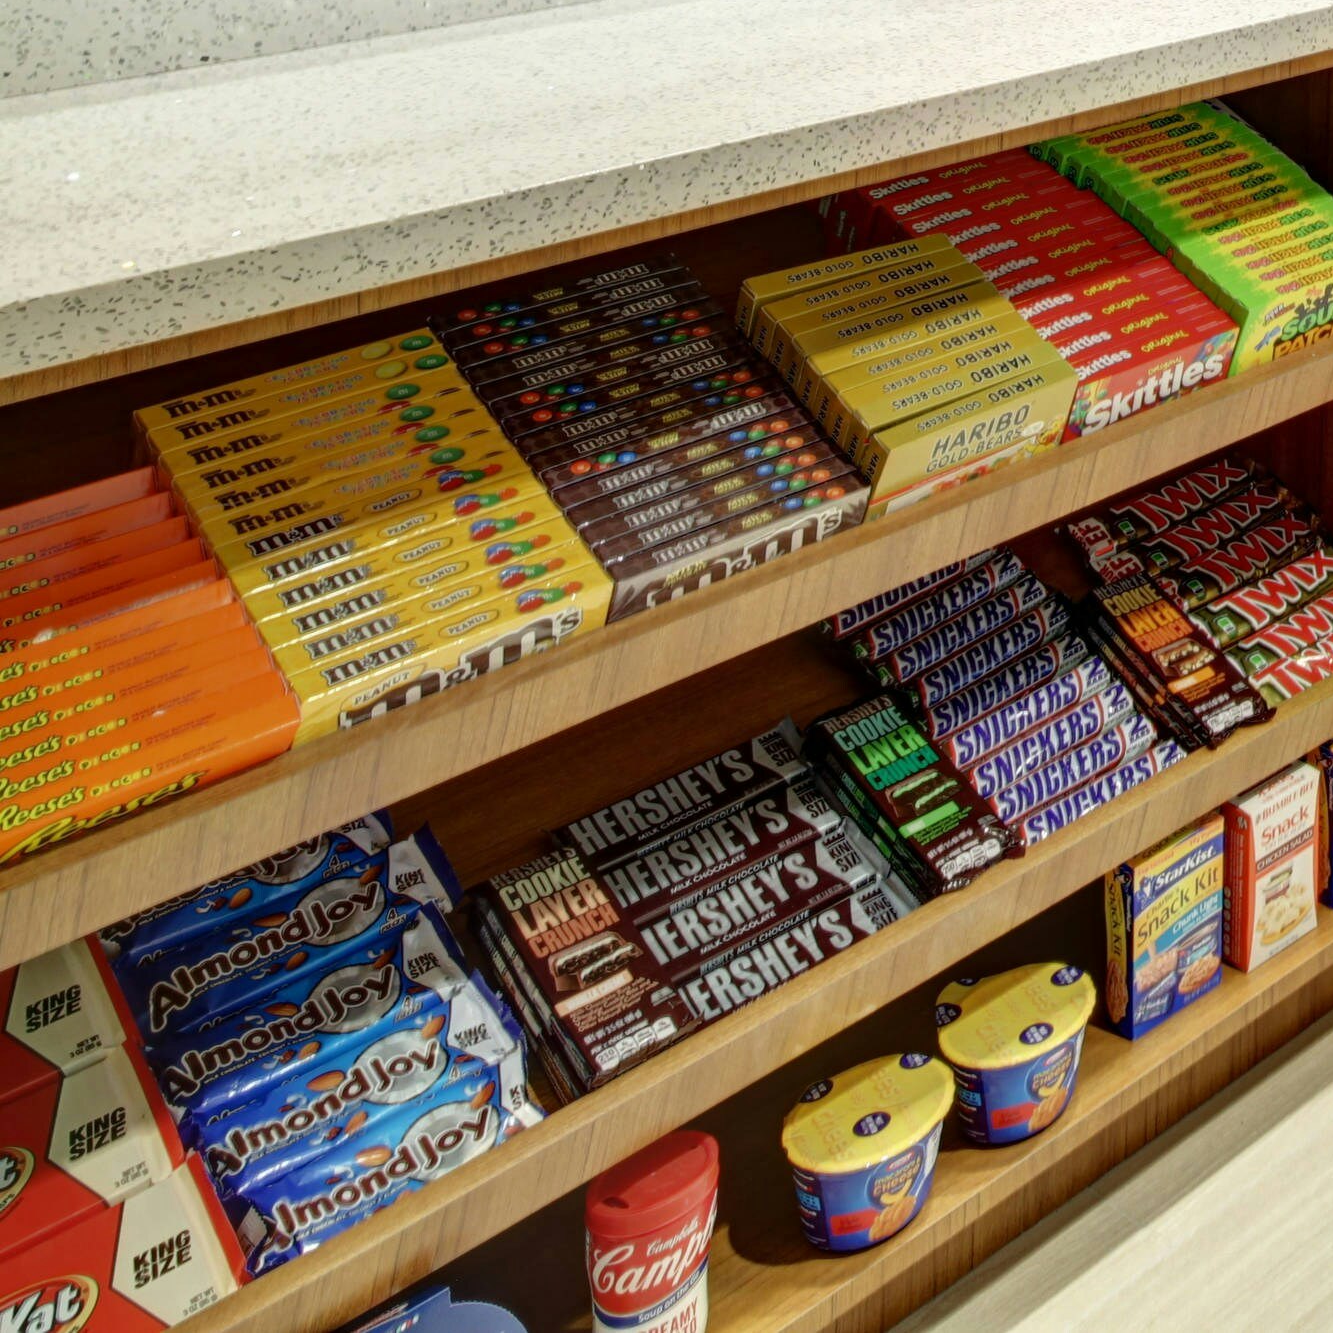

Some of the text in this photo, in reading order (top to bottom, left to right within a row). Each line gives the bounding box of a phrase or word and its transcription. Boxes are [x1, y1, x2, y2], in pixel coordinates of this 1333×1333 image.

[1083, 352, 1224, 437] Skittles
[925, 426, 1025, 476] GOLD-BEARS
[931, 404, 1031, 461] HARIBO
[1116, 459, 1248, 533] TWIX
[386, 514, 431, 536] PEANUT
[402, 540, 446, 561] PEANUT
[416, 564, 461, 585] PEANUT
[430, 587, 475, 609] PEANUT
[868, 568, 997, 659] SNICKERS
[1105, 580, 1163, 619] COOKIE
[1119, 601, 1175, 640] LAYER
[446, 612, 491, 635] PEANUT
[898, 591, 1020, 681] SNICKERS
[1136, 618, 1194, 654] CRUNCH
[918, 611, 1044, 707] SNICKERS
[352, 670, 414, 706] PEANUT
[832, 704, 905, 753] COOKIE
[953, 673, 1079, 769] SNICKERS
[848, 735, 929, 775] LAYER
[971, 698, 1102, 798] SNICKERS
[865, 757, 940, 793] CRUNCH
[994, 725, 1126, 822] SNICKERS
[567, 748, 755, 857] HERSHEY'S
[638, 800, 714, 842] MILK CHOCOLATE
[1261, 805, 1310, 847] Snack
[602, 798, 791, 910] HERSHEY'S
[1154, 845, 1214, 888] StarKist
[1256, 829, 1313, 870] CHICKEN SALAD
[499, 854, 592, 912] COOKIE
[511, 879, 610, 940] LAYER
[1136, 867, 1219, 947] Snack Kit
[1171, 905, 1201, 934] Chunk
[526, 903, 621, 959] CRUNCH
[147, 881, 382, 1033] Almond Joy
[24, 983, 82, 1018] KING
[25, 998, 82, 1034] SIZE
[162, 961, 395, 1100] Almond Joy
[68, 1105, 127, 1146] KING
[205, 1037, 440, 1176] Almond Joy
[69, 1121, 127, 1162] SIZE
[132, 1227, 191, 1272] KING
[133, 1245, 193, 1290] SIZE
[638, 1298, 666, 1323] Soup
